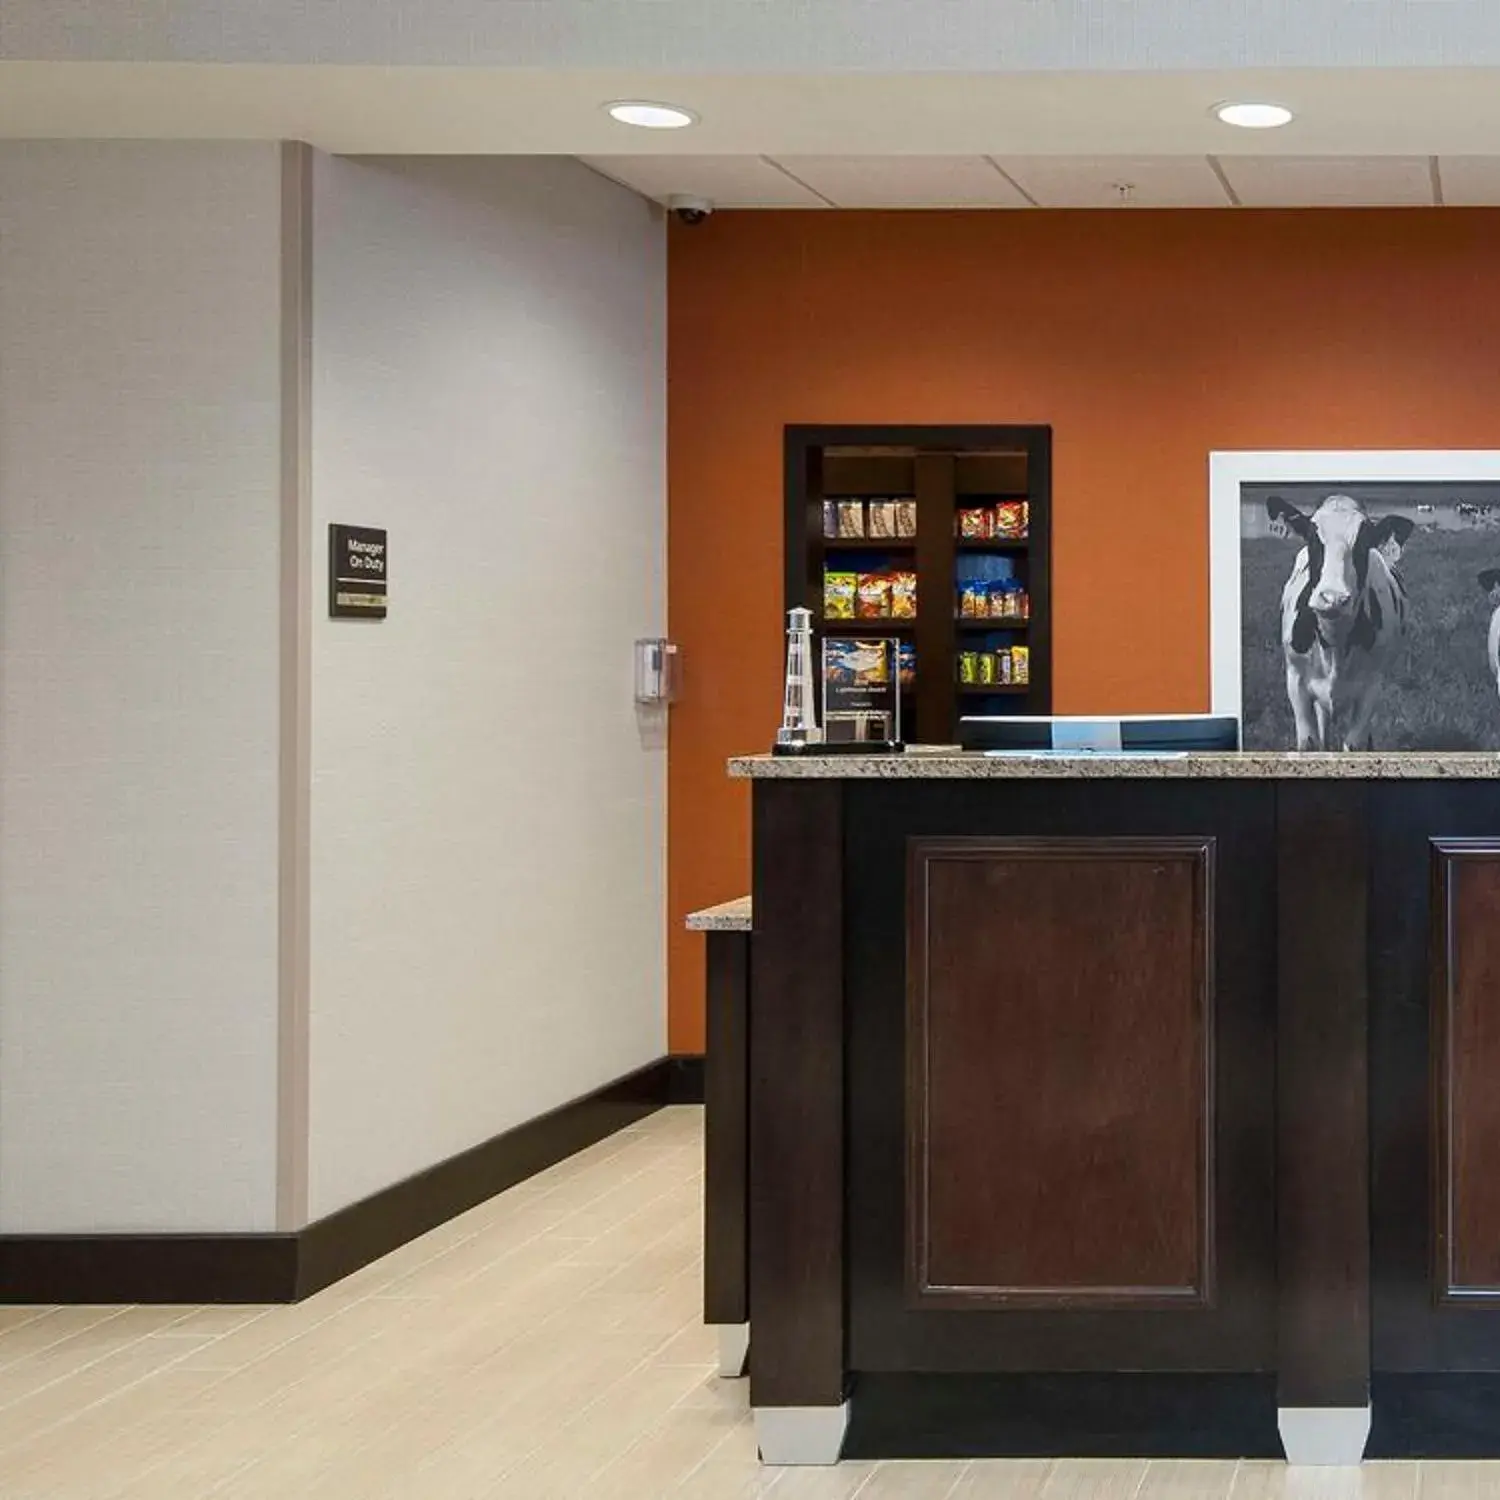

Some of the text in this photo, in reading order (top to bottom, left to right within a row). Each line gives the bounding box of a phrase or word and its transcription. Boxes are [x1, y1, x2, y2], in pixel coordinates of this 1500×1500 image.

[347, 539, 385, 557] Manager
[349, 555, 385, 573] On Duty
